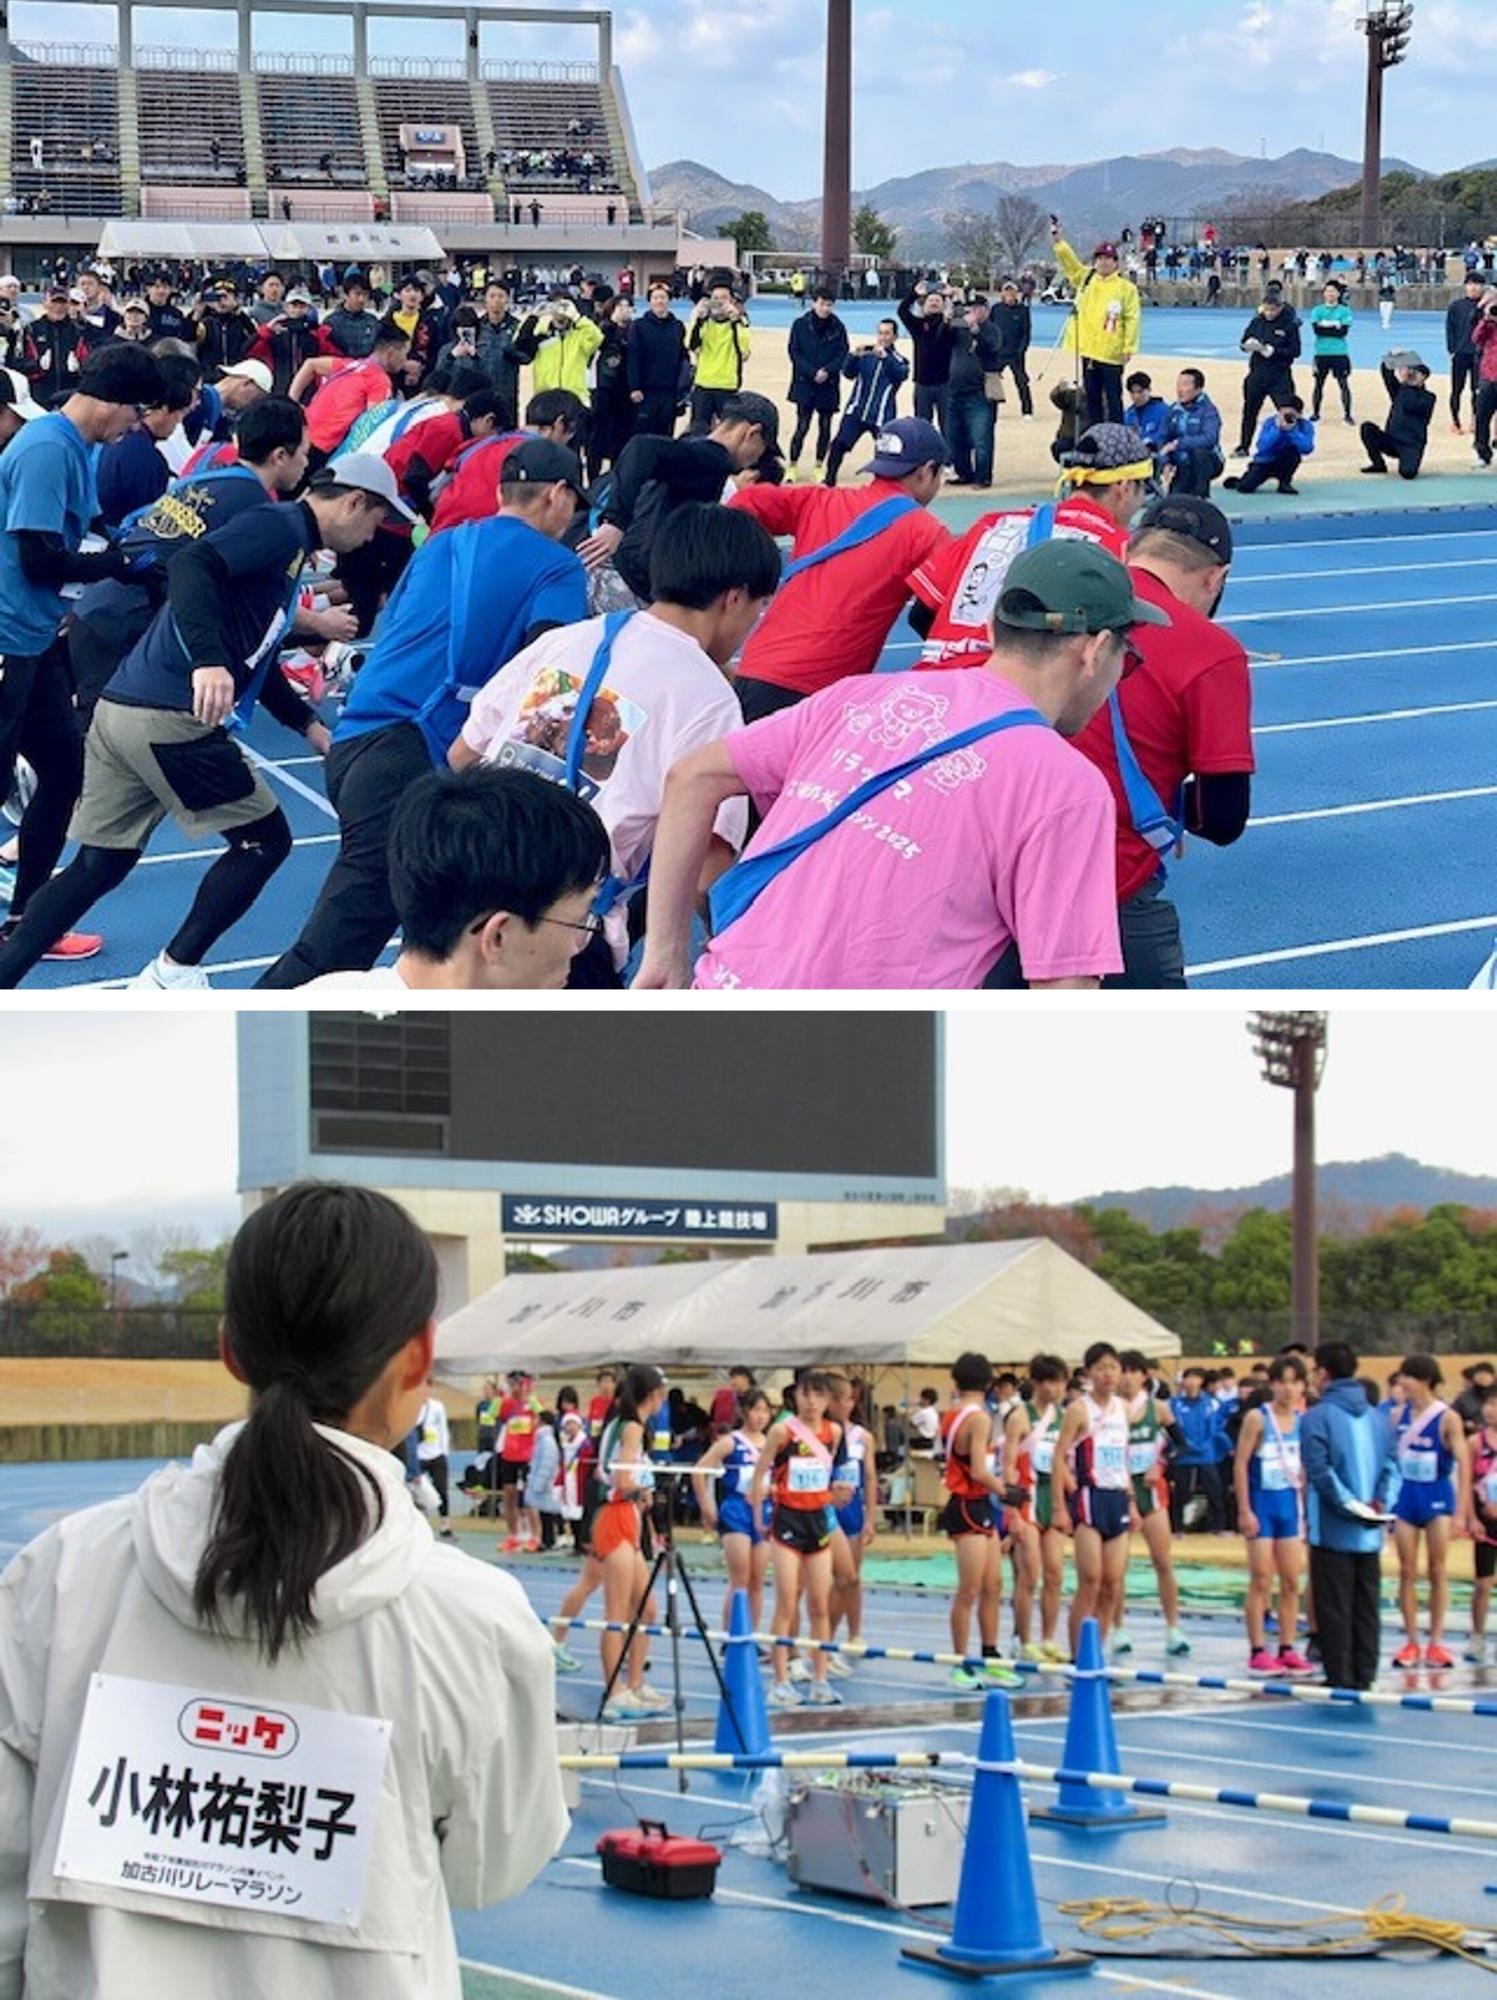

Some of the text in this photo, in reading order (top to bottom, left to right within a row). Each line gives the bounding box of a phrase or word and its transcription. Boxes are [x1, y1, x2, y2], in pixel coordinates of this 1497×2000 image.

[874, 821, 922, 861] 2025
[542, 1204, 768, 1231] SHOWAグループ 陸上競技場
[195, 1704, 285, 1751] ニッケ
[87, 1755, 357, 1861] 小林祐梨子
[120, 1859, 303, 1905] 加古川リレーマラソン
